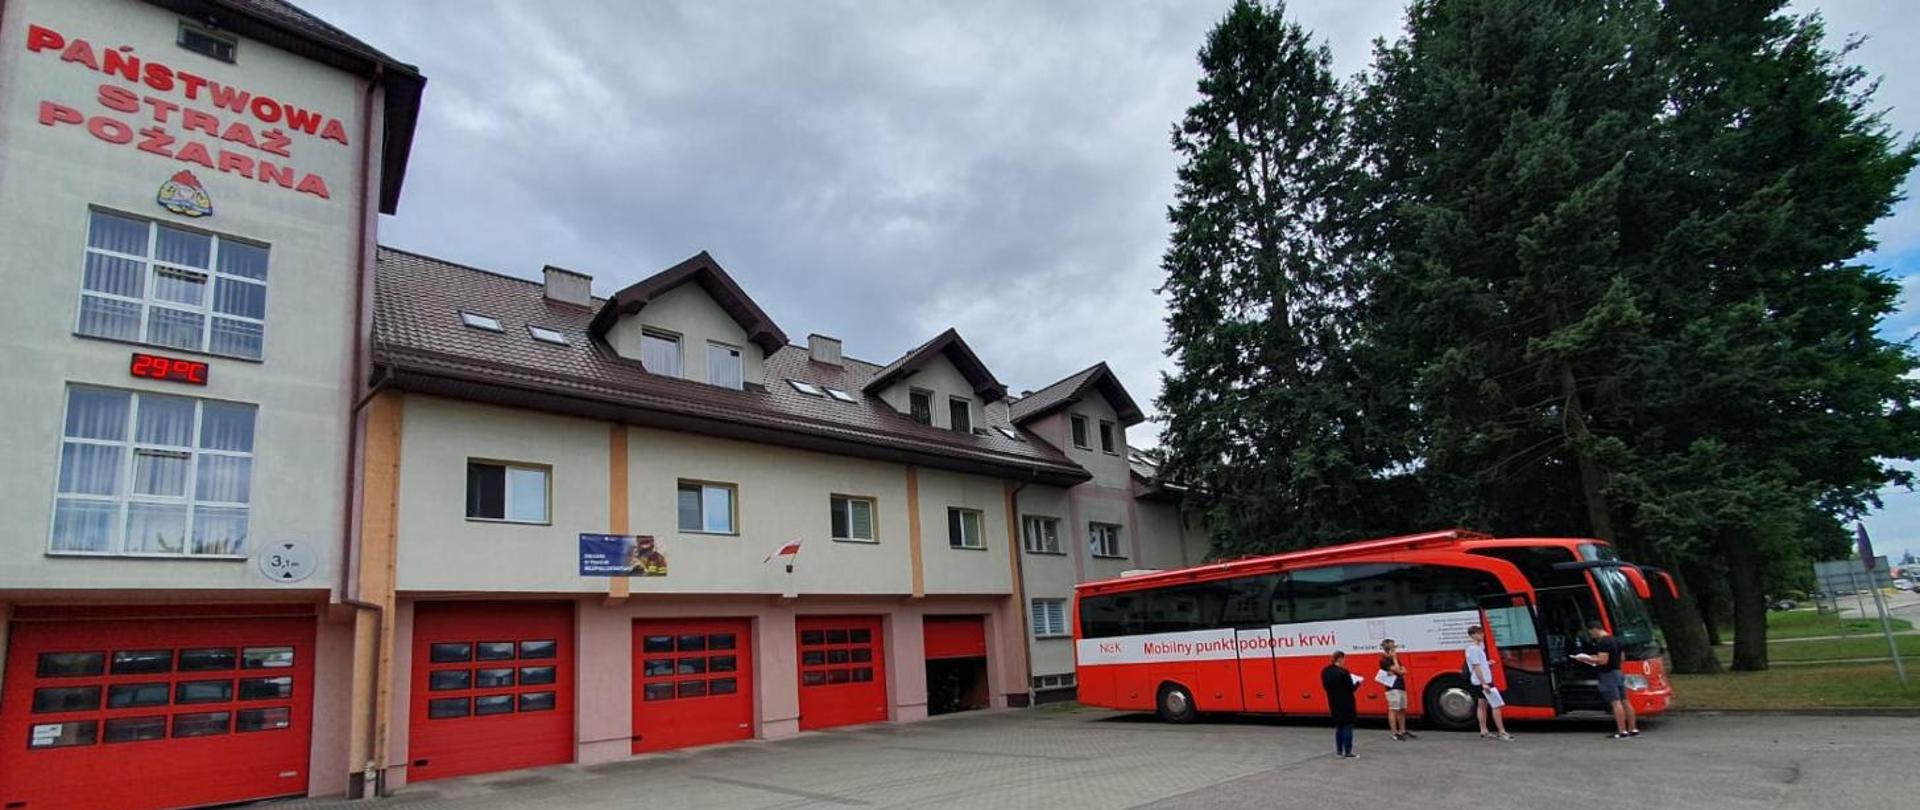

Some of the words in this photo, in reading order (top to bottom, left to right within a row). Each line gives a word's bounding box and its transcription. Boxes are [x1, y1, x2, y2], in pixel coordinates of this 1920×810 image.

[26, 24, 349, 146] PAŃSTWOWA
[97, 83, 292, 158] STRAŻ
[38, 100, 330, 200] POŻARNA
[1144, 641, 1192, 655] Mobilny
[1196, 638, 1235, 655] punkt
[1240, 635, 1294, 652] poboru
[1298, 631, 1337, 646] krwi
